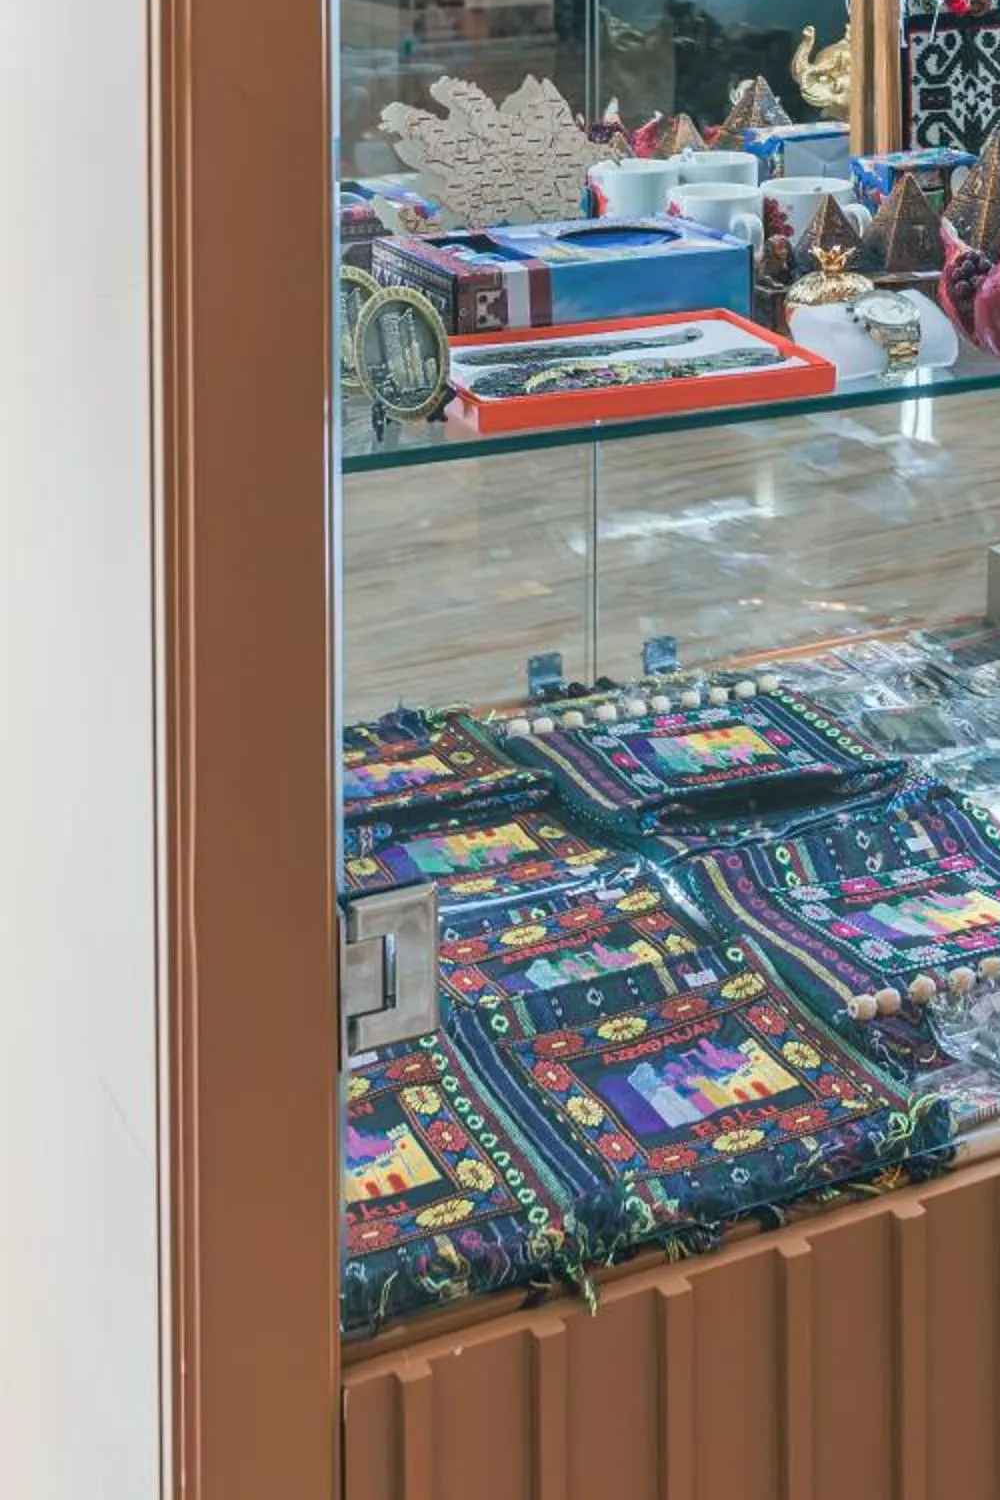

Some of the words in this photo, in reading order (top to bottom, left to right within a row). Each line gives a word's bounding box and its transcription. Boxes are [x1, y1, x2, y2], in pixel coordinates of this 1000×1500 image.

[602, 1017, 721, 1066] AZERBAIJAN
[690, 1105, 779, 1138] Baku
[346, 1200, 409, 1224] aku
